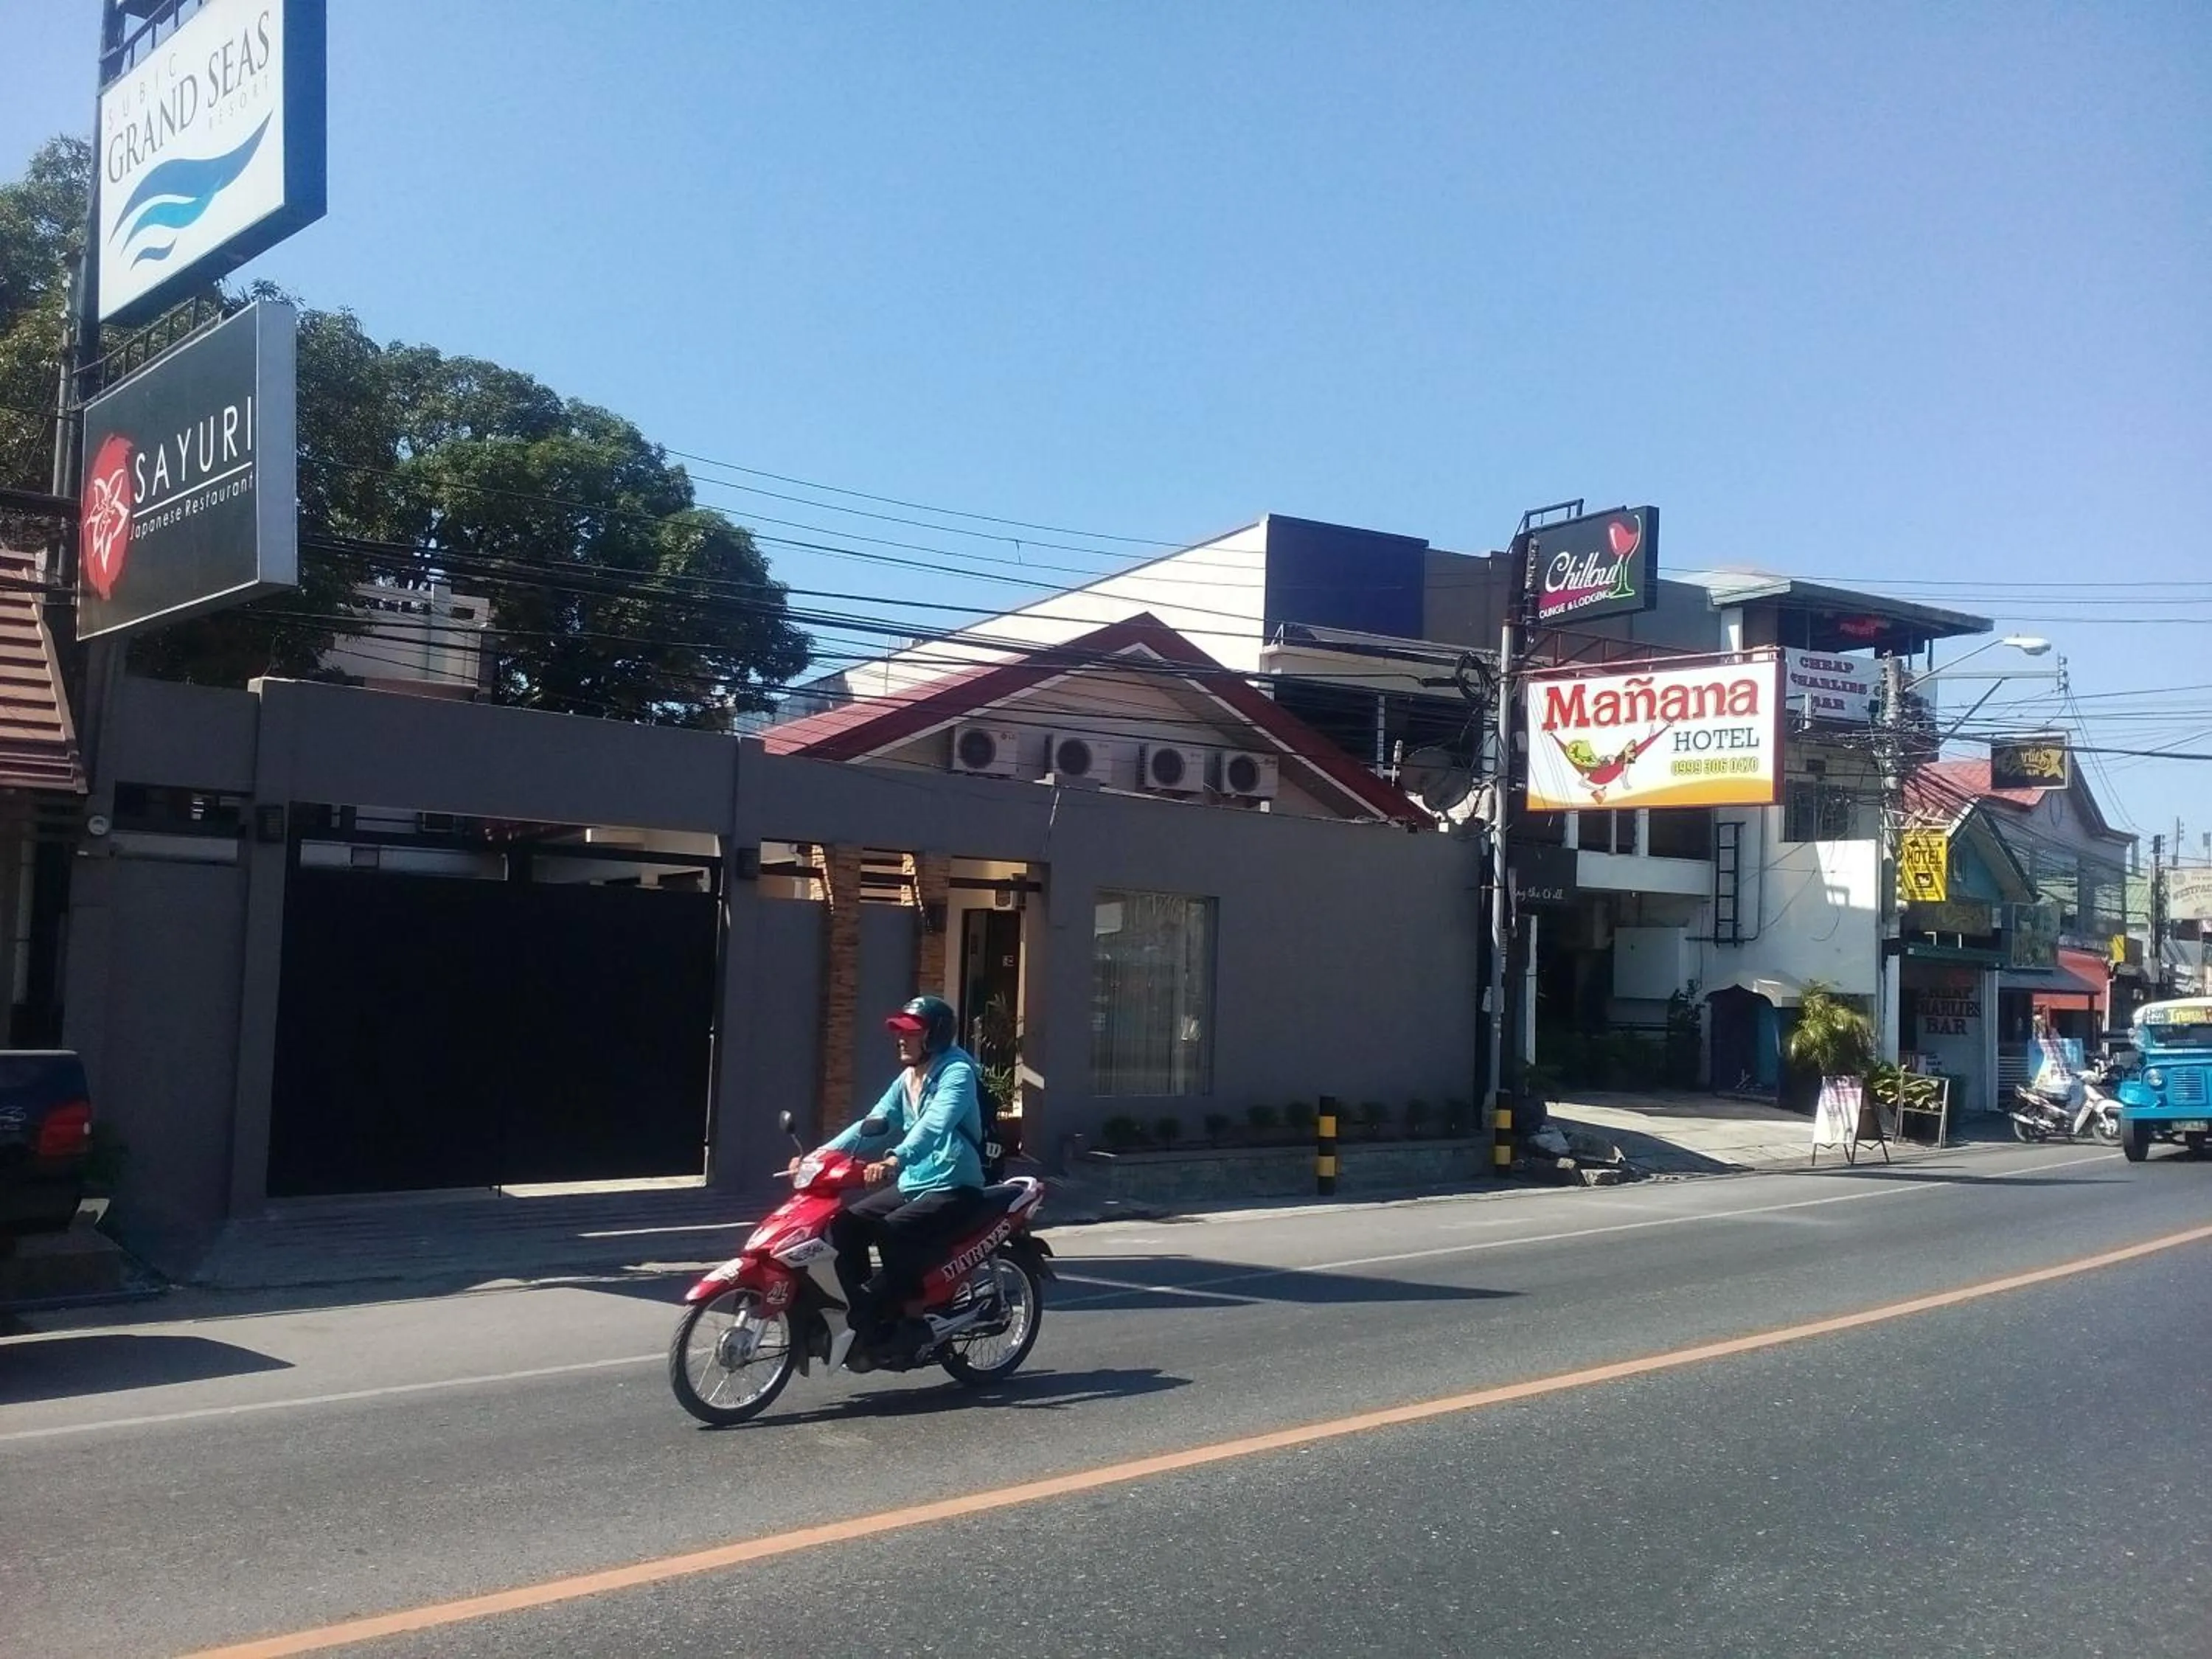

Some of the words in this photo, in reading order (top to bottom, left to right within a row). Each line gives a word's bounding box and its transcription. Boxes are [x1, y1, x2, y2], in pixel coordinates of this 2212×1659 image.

[108, 52, 177, 130] SUBIC
[108, 74, 198, 184] GRAND
[207, 10, 270, 108] SEAS
[134, 396, 252, 504] SAYURI
[129, 507, 183, 541] Japanese
[185, 471, 254, 518] Restaurant
[1542, 676, 1760, 731] Mañana
[1672, 727, 1760, 753] HOTEL
[1906, 849, 1942, 865] HOTEL
